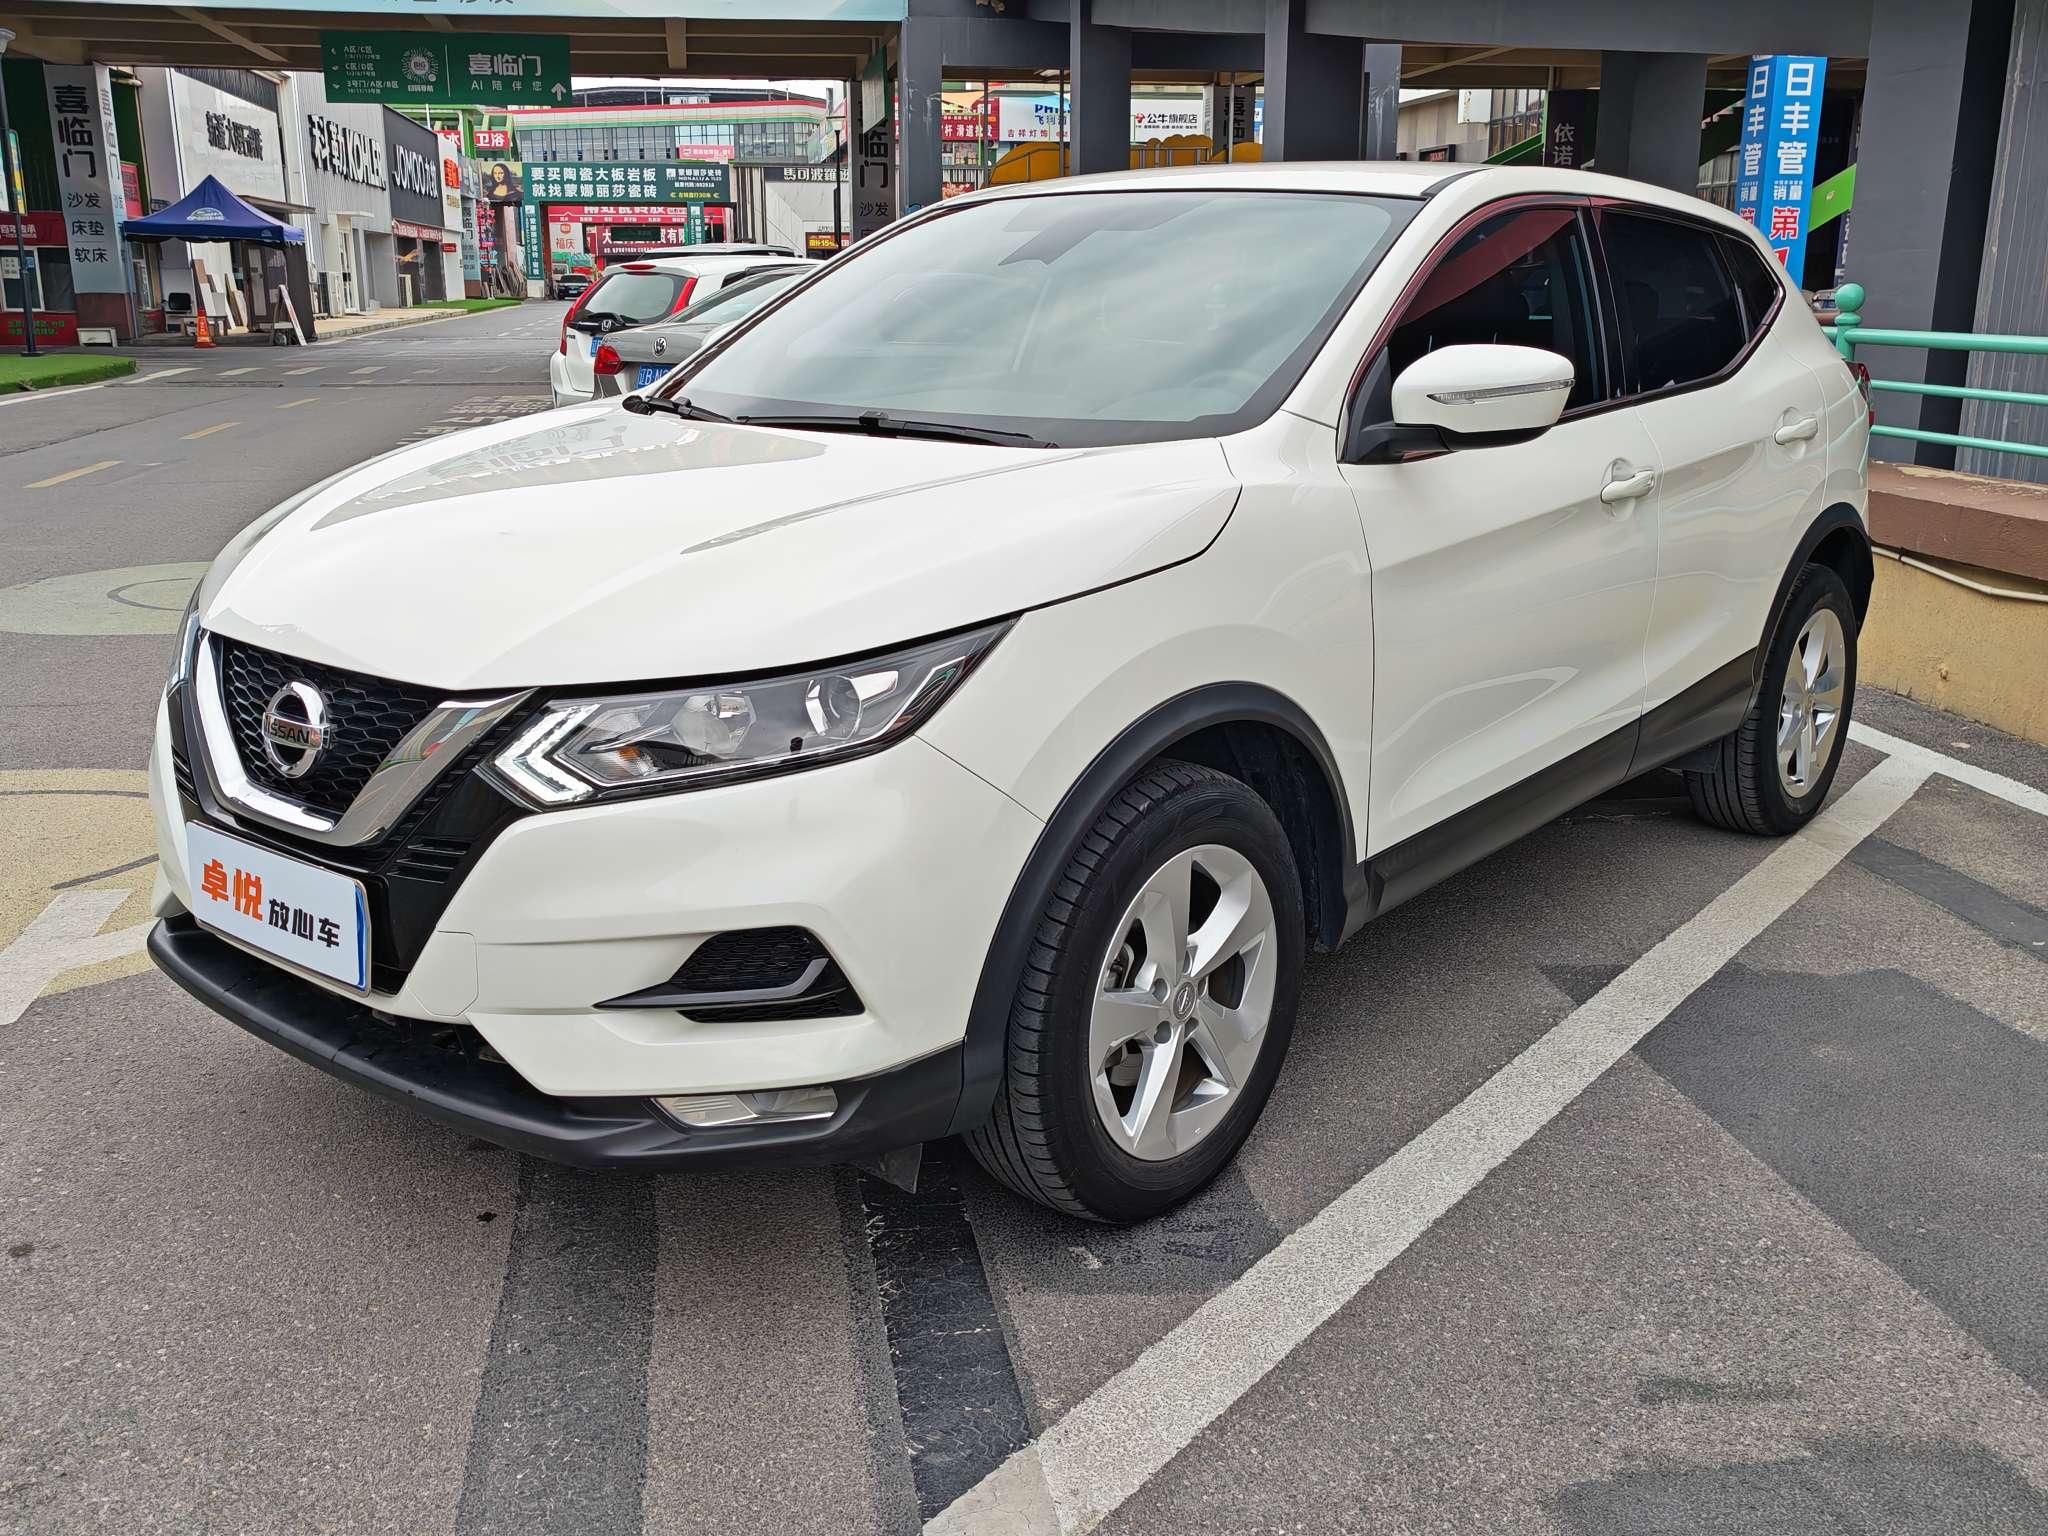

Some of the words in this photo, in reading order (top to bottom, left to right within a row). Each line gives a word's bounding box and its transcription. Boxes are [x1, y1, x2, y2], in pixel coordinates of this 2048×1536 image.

[468, 53, 541, 76] 喜临门
[1147, 113, 1198, 124] 公牛旗舰店
[1744, 65, 1769, 177] 日丰管
[1777, 63, 1814, 175] 日丰管
[53, 84, 98, 179] 喜临门
[475, 133, 505, 147] 卫浴
[307, 114, 348, 178] 科勒
[342, 128, 387, 191] KOHLER
[1553, 122, 1575, 166] 依诺
[392, 144, 426, 196] JOMOO
[531, 167, 657, 182] 要买陶瓷大板岩板
[67, 191, 102, 209] 沙发
[532, 184, 657, 198] 就找蒙娜丽莎瓷砖
[859, 202, 889, 217] 沙发
[71, 220, 105, 237] 床垫
[74, 247, 109, 264] 软床
[265, 715, 310, 745] NISSAN
[201, 858, 264, 921] 卓悦
[268, 898, 341, 949] 放心车
